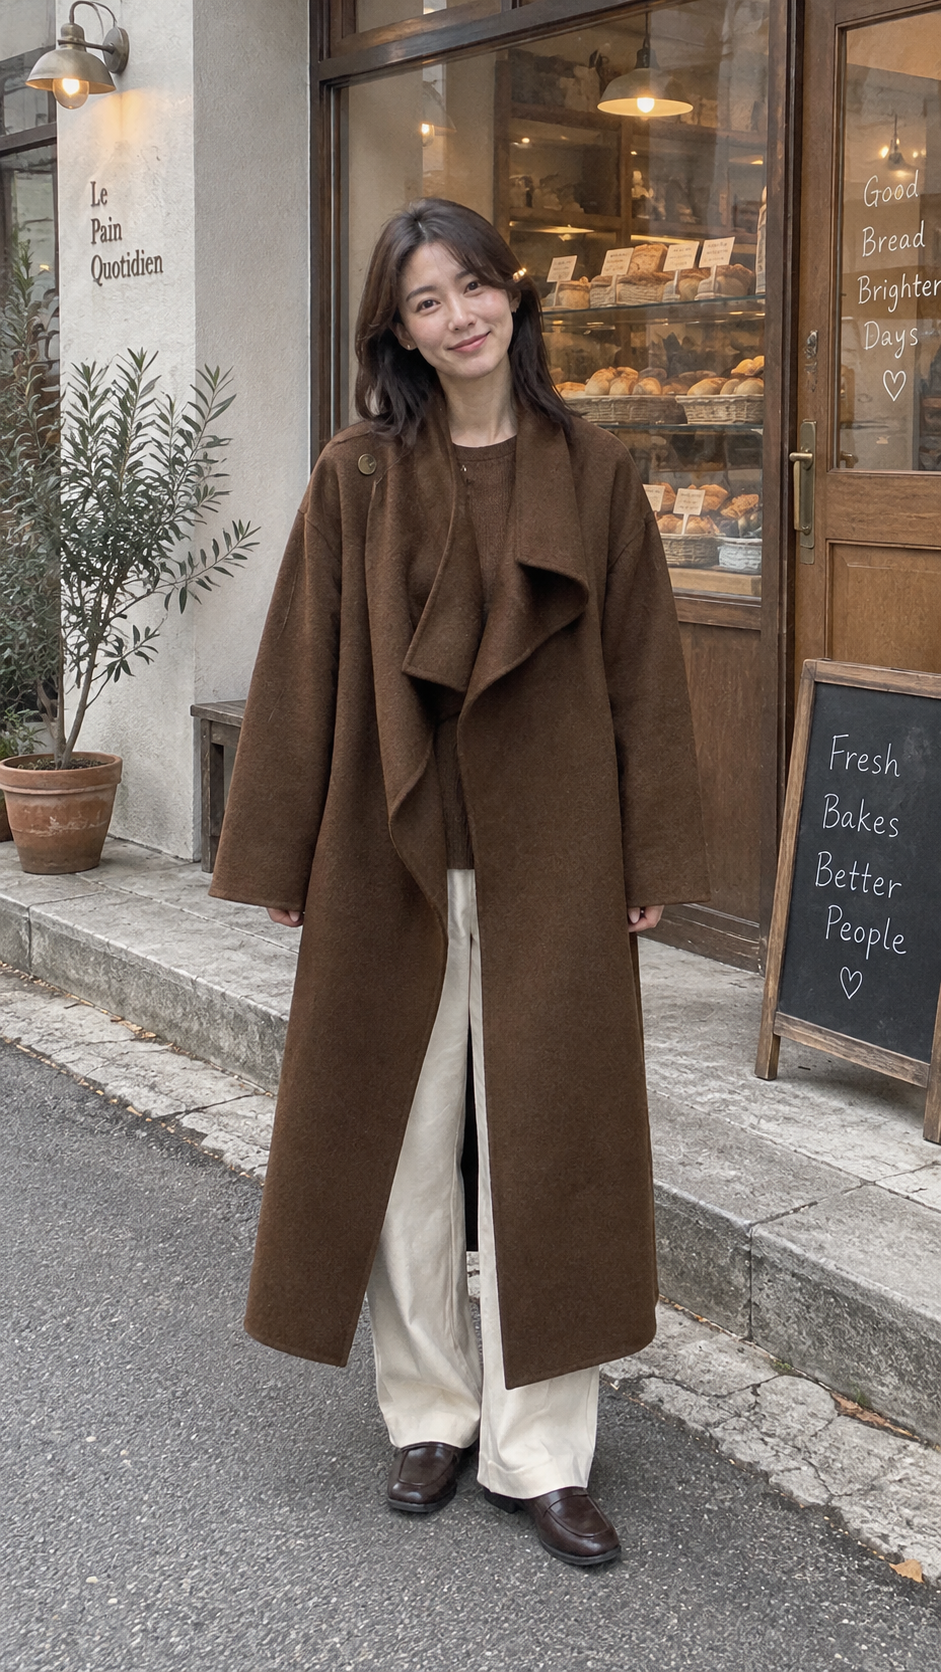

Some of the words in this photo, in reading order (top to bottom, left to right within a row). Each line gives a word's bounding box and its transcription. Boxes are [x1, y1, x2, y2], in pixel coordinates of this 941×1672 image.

[90, 181, 107, 207] Le
[863, 169, 919, 208] Good
[90, 216, 123, 245] Pain
[862, 219, 926, 257] Bread
[90, 249, 164, 287] Quotidien
[857, 273, 941, 313] Brighter
[863, 320, 919, 359] Days
[829, 733, 901, 778] Fresh
[822, 793, 899, 838] Bakes
[815, 850, 903, 899] Better
[825, 904, 907, 960] People
